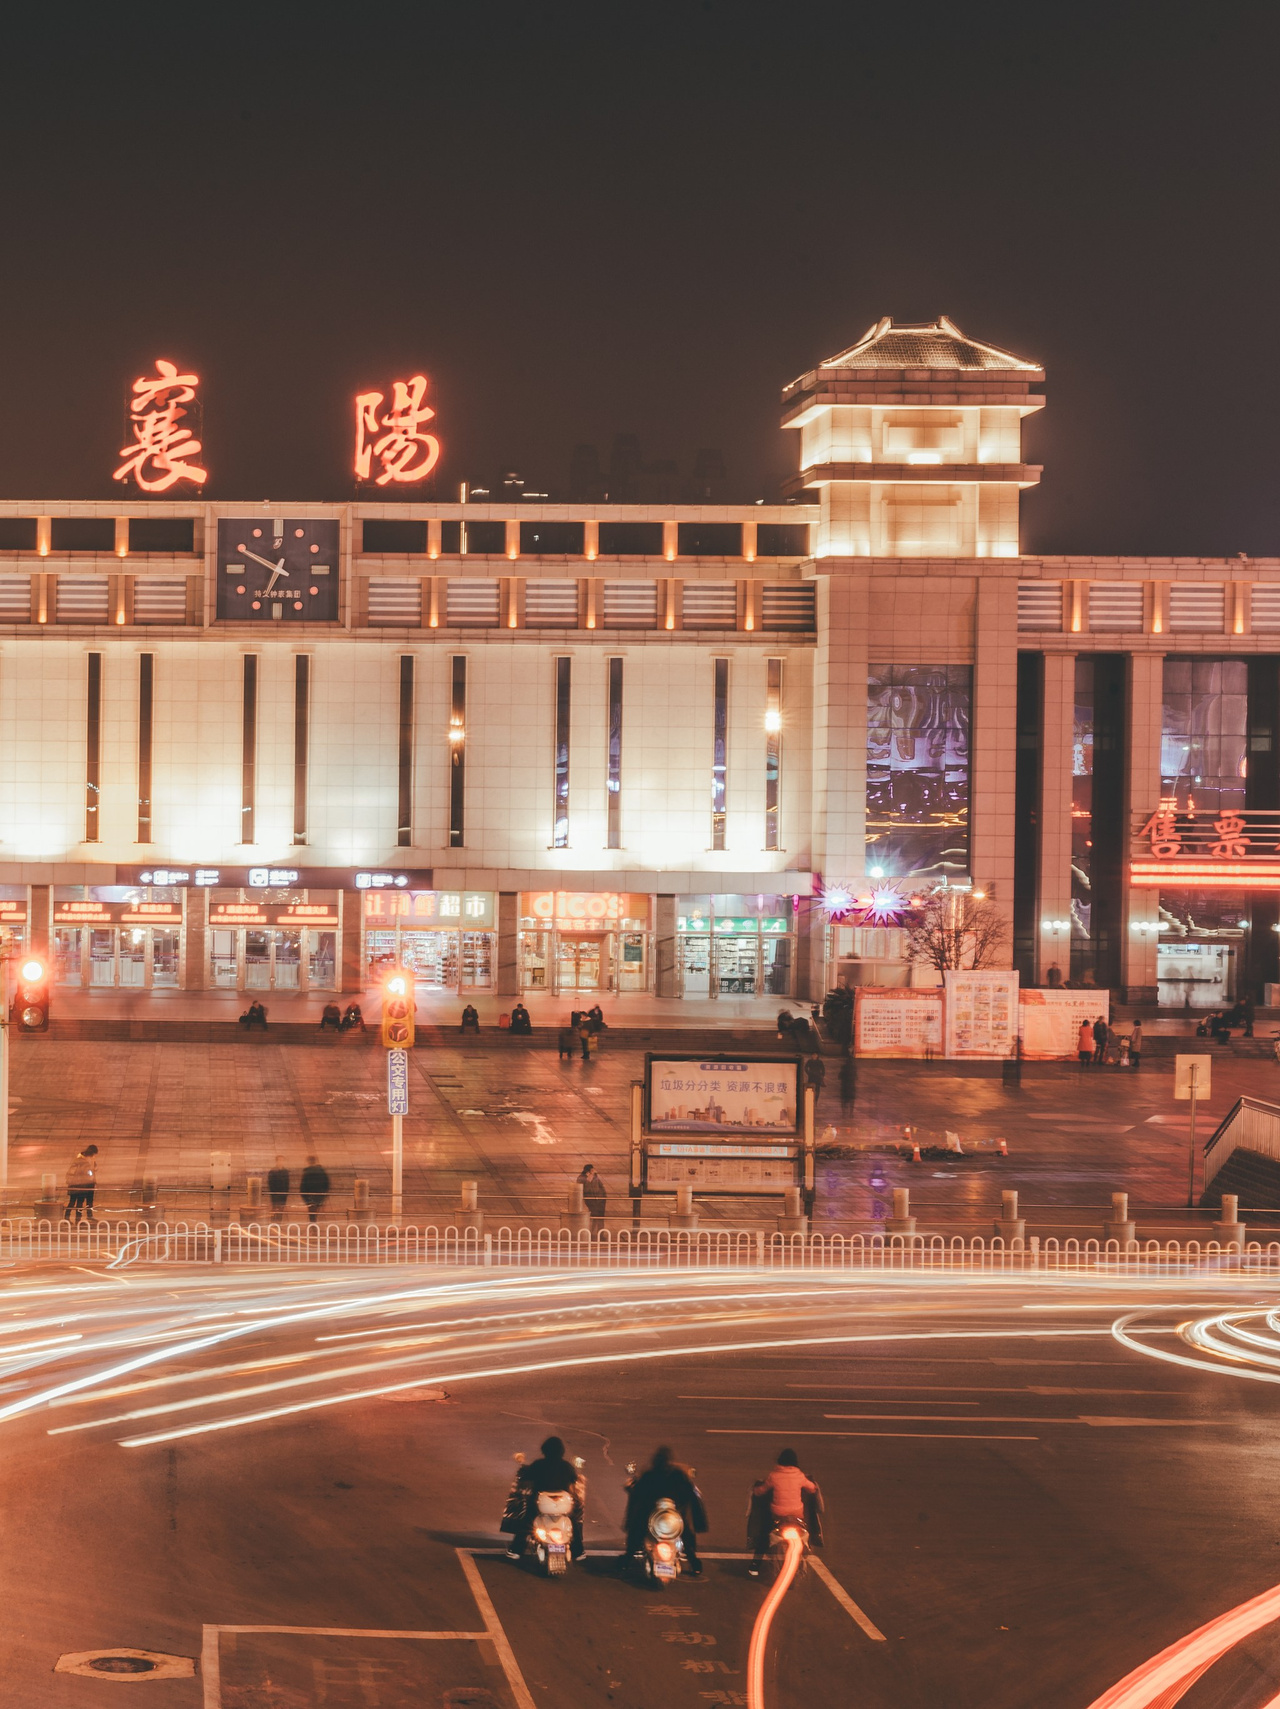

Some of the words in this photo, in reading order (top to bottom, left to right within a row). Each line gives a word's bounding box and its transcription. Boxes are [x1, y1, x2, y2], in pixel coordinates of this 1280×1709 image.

[1138, 809, 1280, 860] 售票
[391, 1052, 406, 1112] 公交专用灯
[660, 1079, 721, 1092] 垃圾分分类
[726, 1080, 788, 1094] 资源不浪费
